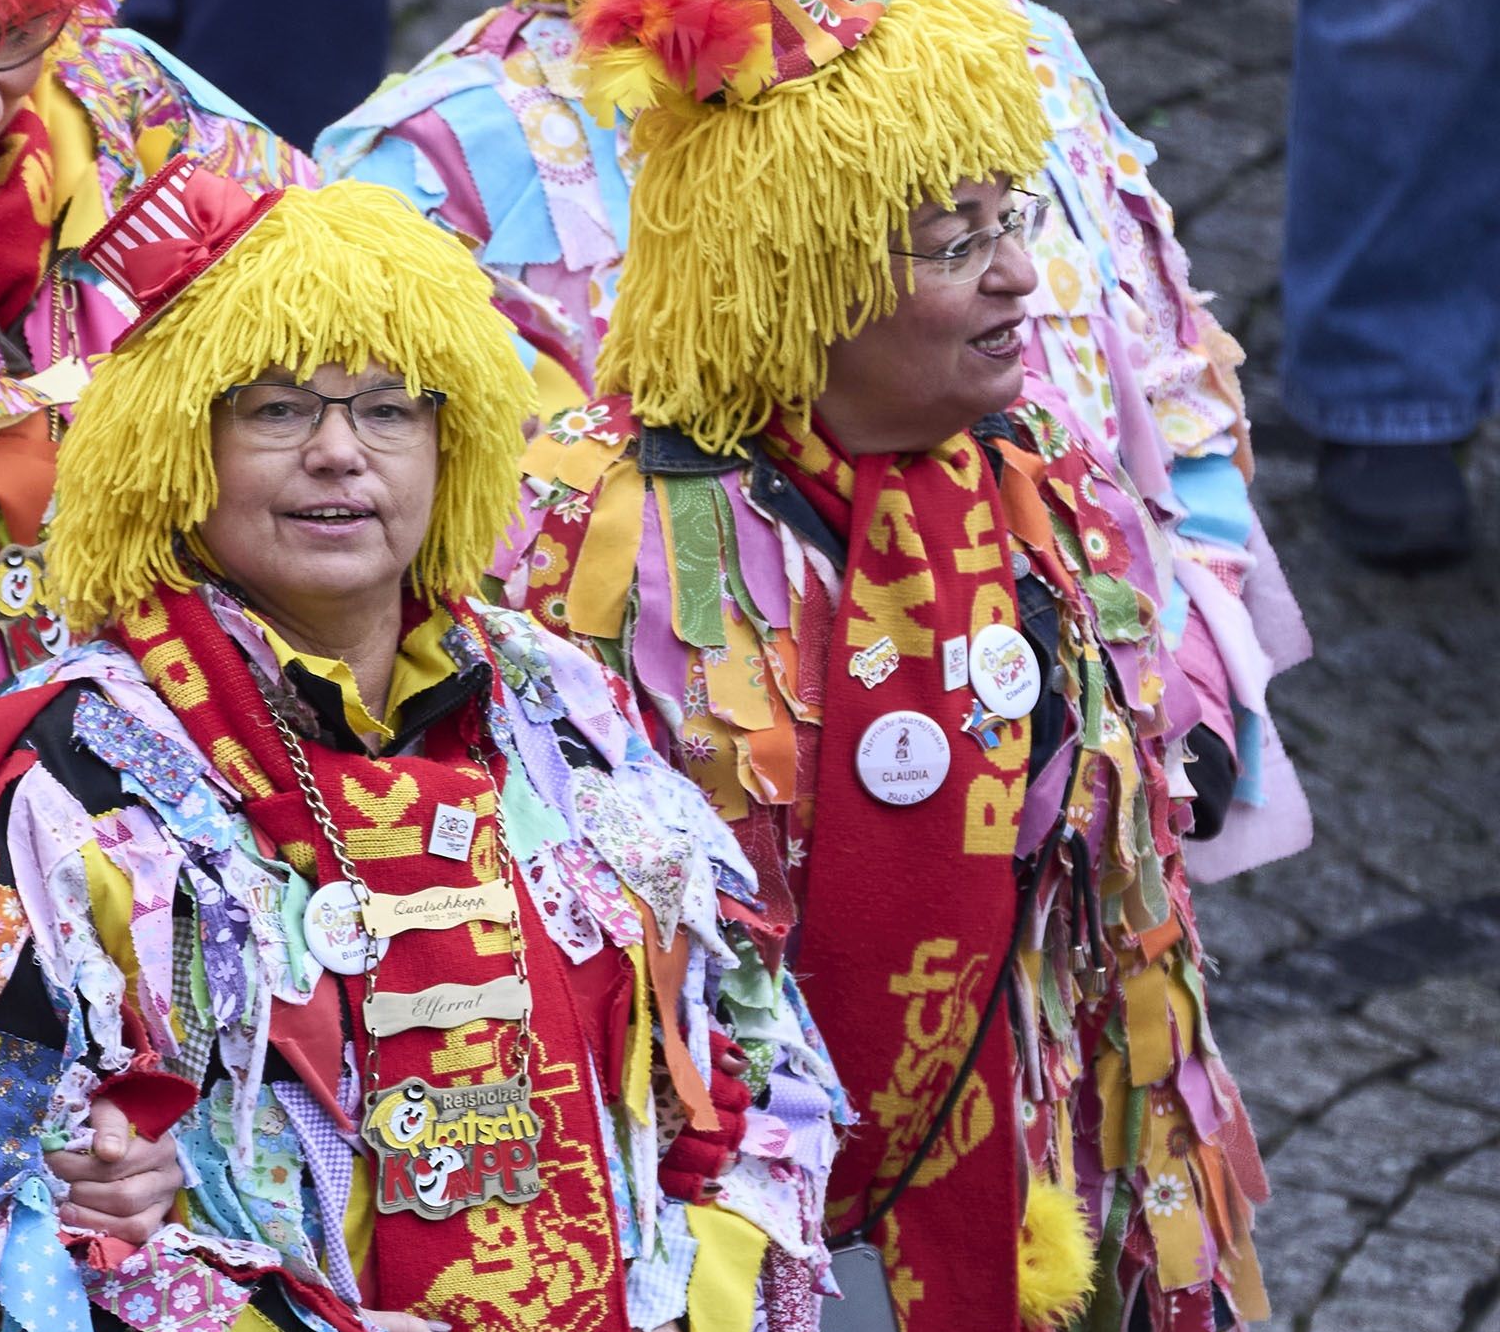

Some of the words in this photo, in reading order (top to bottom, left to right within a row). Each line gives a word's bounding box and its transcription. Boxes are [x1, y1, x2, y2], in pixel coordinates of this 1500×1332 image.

[881, 769, 930, 784] CLAUDIA
[411, 992, 484, 1022] Elferrat
[442, 1087, 527, 1110] Reisholzer
